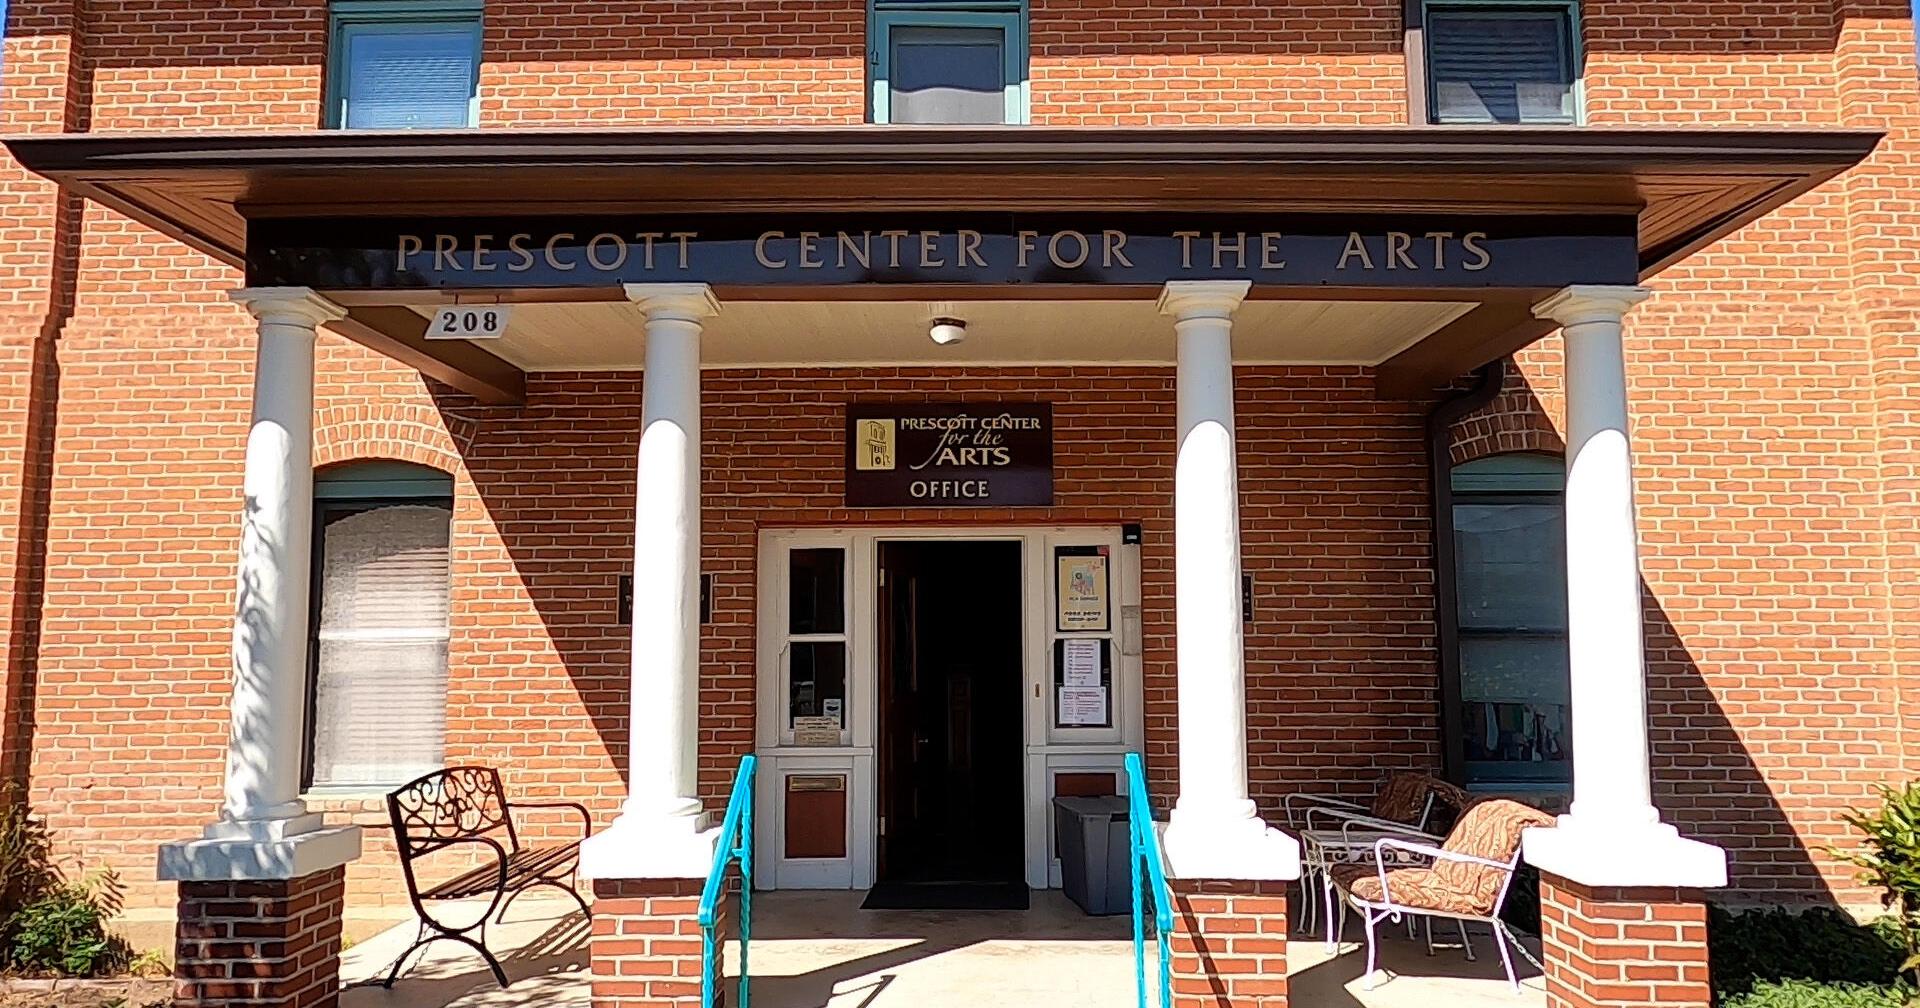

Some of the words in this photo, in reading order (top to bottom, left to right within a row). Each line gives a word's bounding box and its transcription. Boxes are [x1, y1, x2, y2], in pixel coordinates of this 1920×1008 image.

[396, 232, 698, 271] PRESCOTT
[755, 230, 988, 269] CENTER
[1016, 230, 1134, 269] FOR
[1172, 231, 1287, 269] THE
[1336, 231, 1492, 271] ARTS
[443, 311, 497, 332] 208
[901, 414, 978, 430] PRESCOTT
[981, 413, 1041, 429] CENTER
[973, 428, 1003, 446] the
[936, 447, 1011, 466] ARTS
[910, 481, 989, 498] OFFICE
